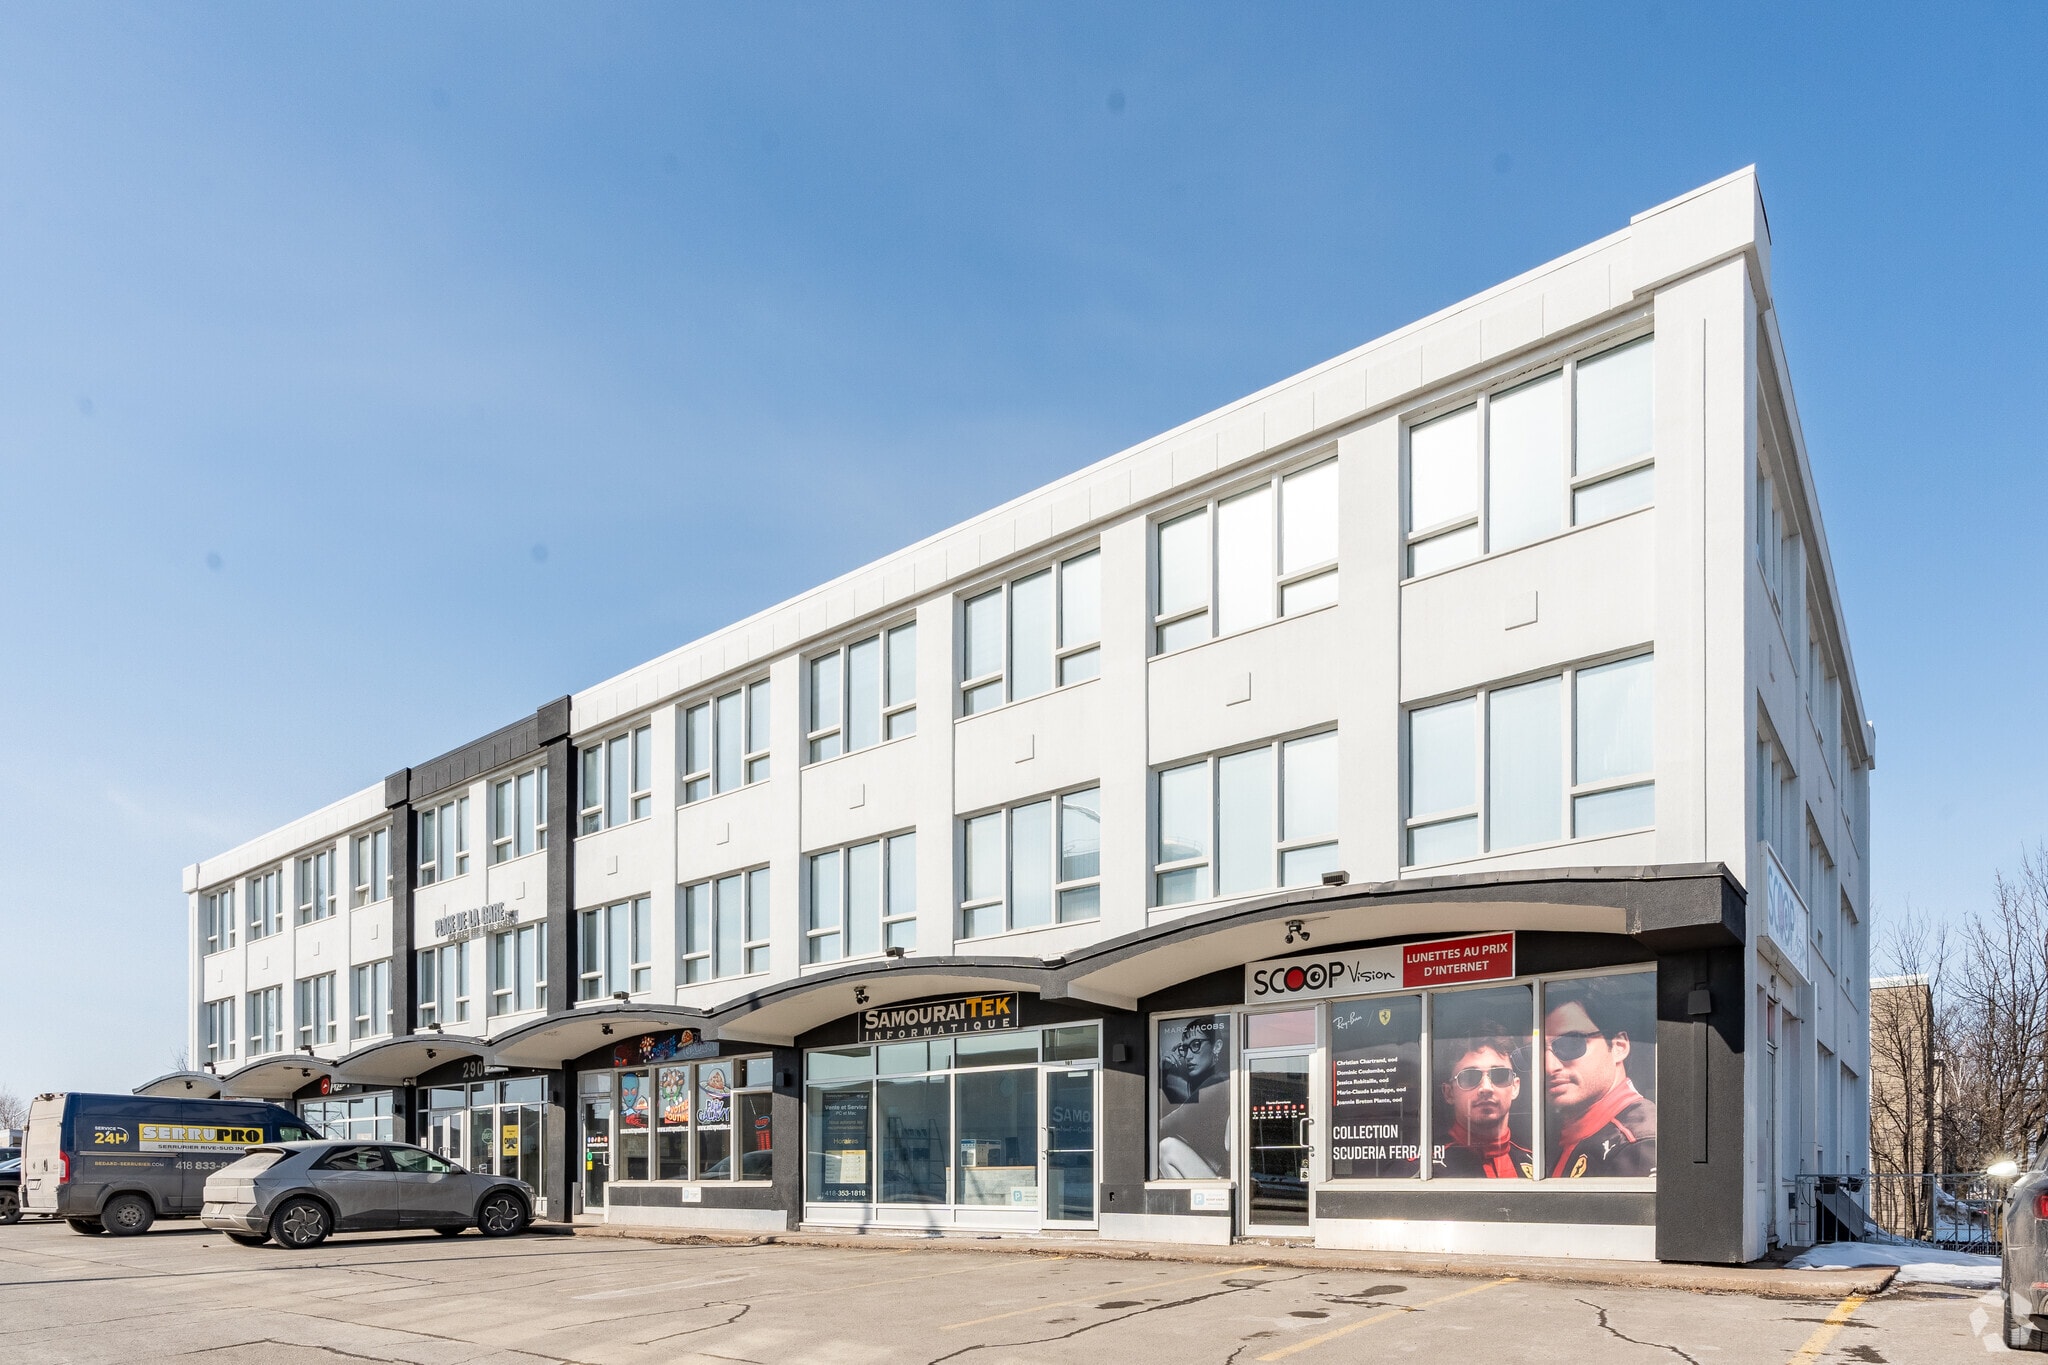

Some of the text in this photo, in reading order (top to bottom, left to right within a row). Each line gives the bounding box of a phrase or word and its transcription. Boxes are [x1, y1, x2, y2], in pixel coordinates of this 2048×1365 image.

[434, 902, 504, 937] PLACE DE LA GARE
[1406, 942, 1508, 964] LUNETTES AU PRIX
[1424, 960, 1490, 977] D'INTERNET
[1254, 960, 1395, 996] SCOOP Vision
[866, 1018, 1010, 1041] INFORMATIQUE
[1190, 1022, 1224, 1032] JACOBS
[1332, 1012, 1362, 1030] Ray-Ban
[463, 1061, 489, 1078] 290
[94, 1132, 127, 1144] 24H
[142, 1126, 260, 1142] SERRUPRO
[1333, 1125, 1398, 1139] COLLECTION
[1333, 1146, 1386, 1160] SCUDERIA
[175, 1162, 234, 1170] 418 833-8
